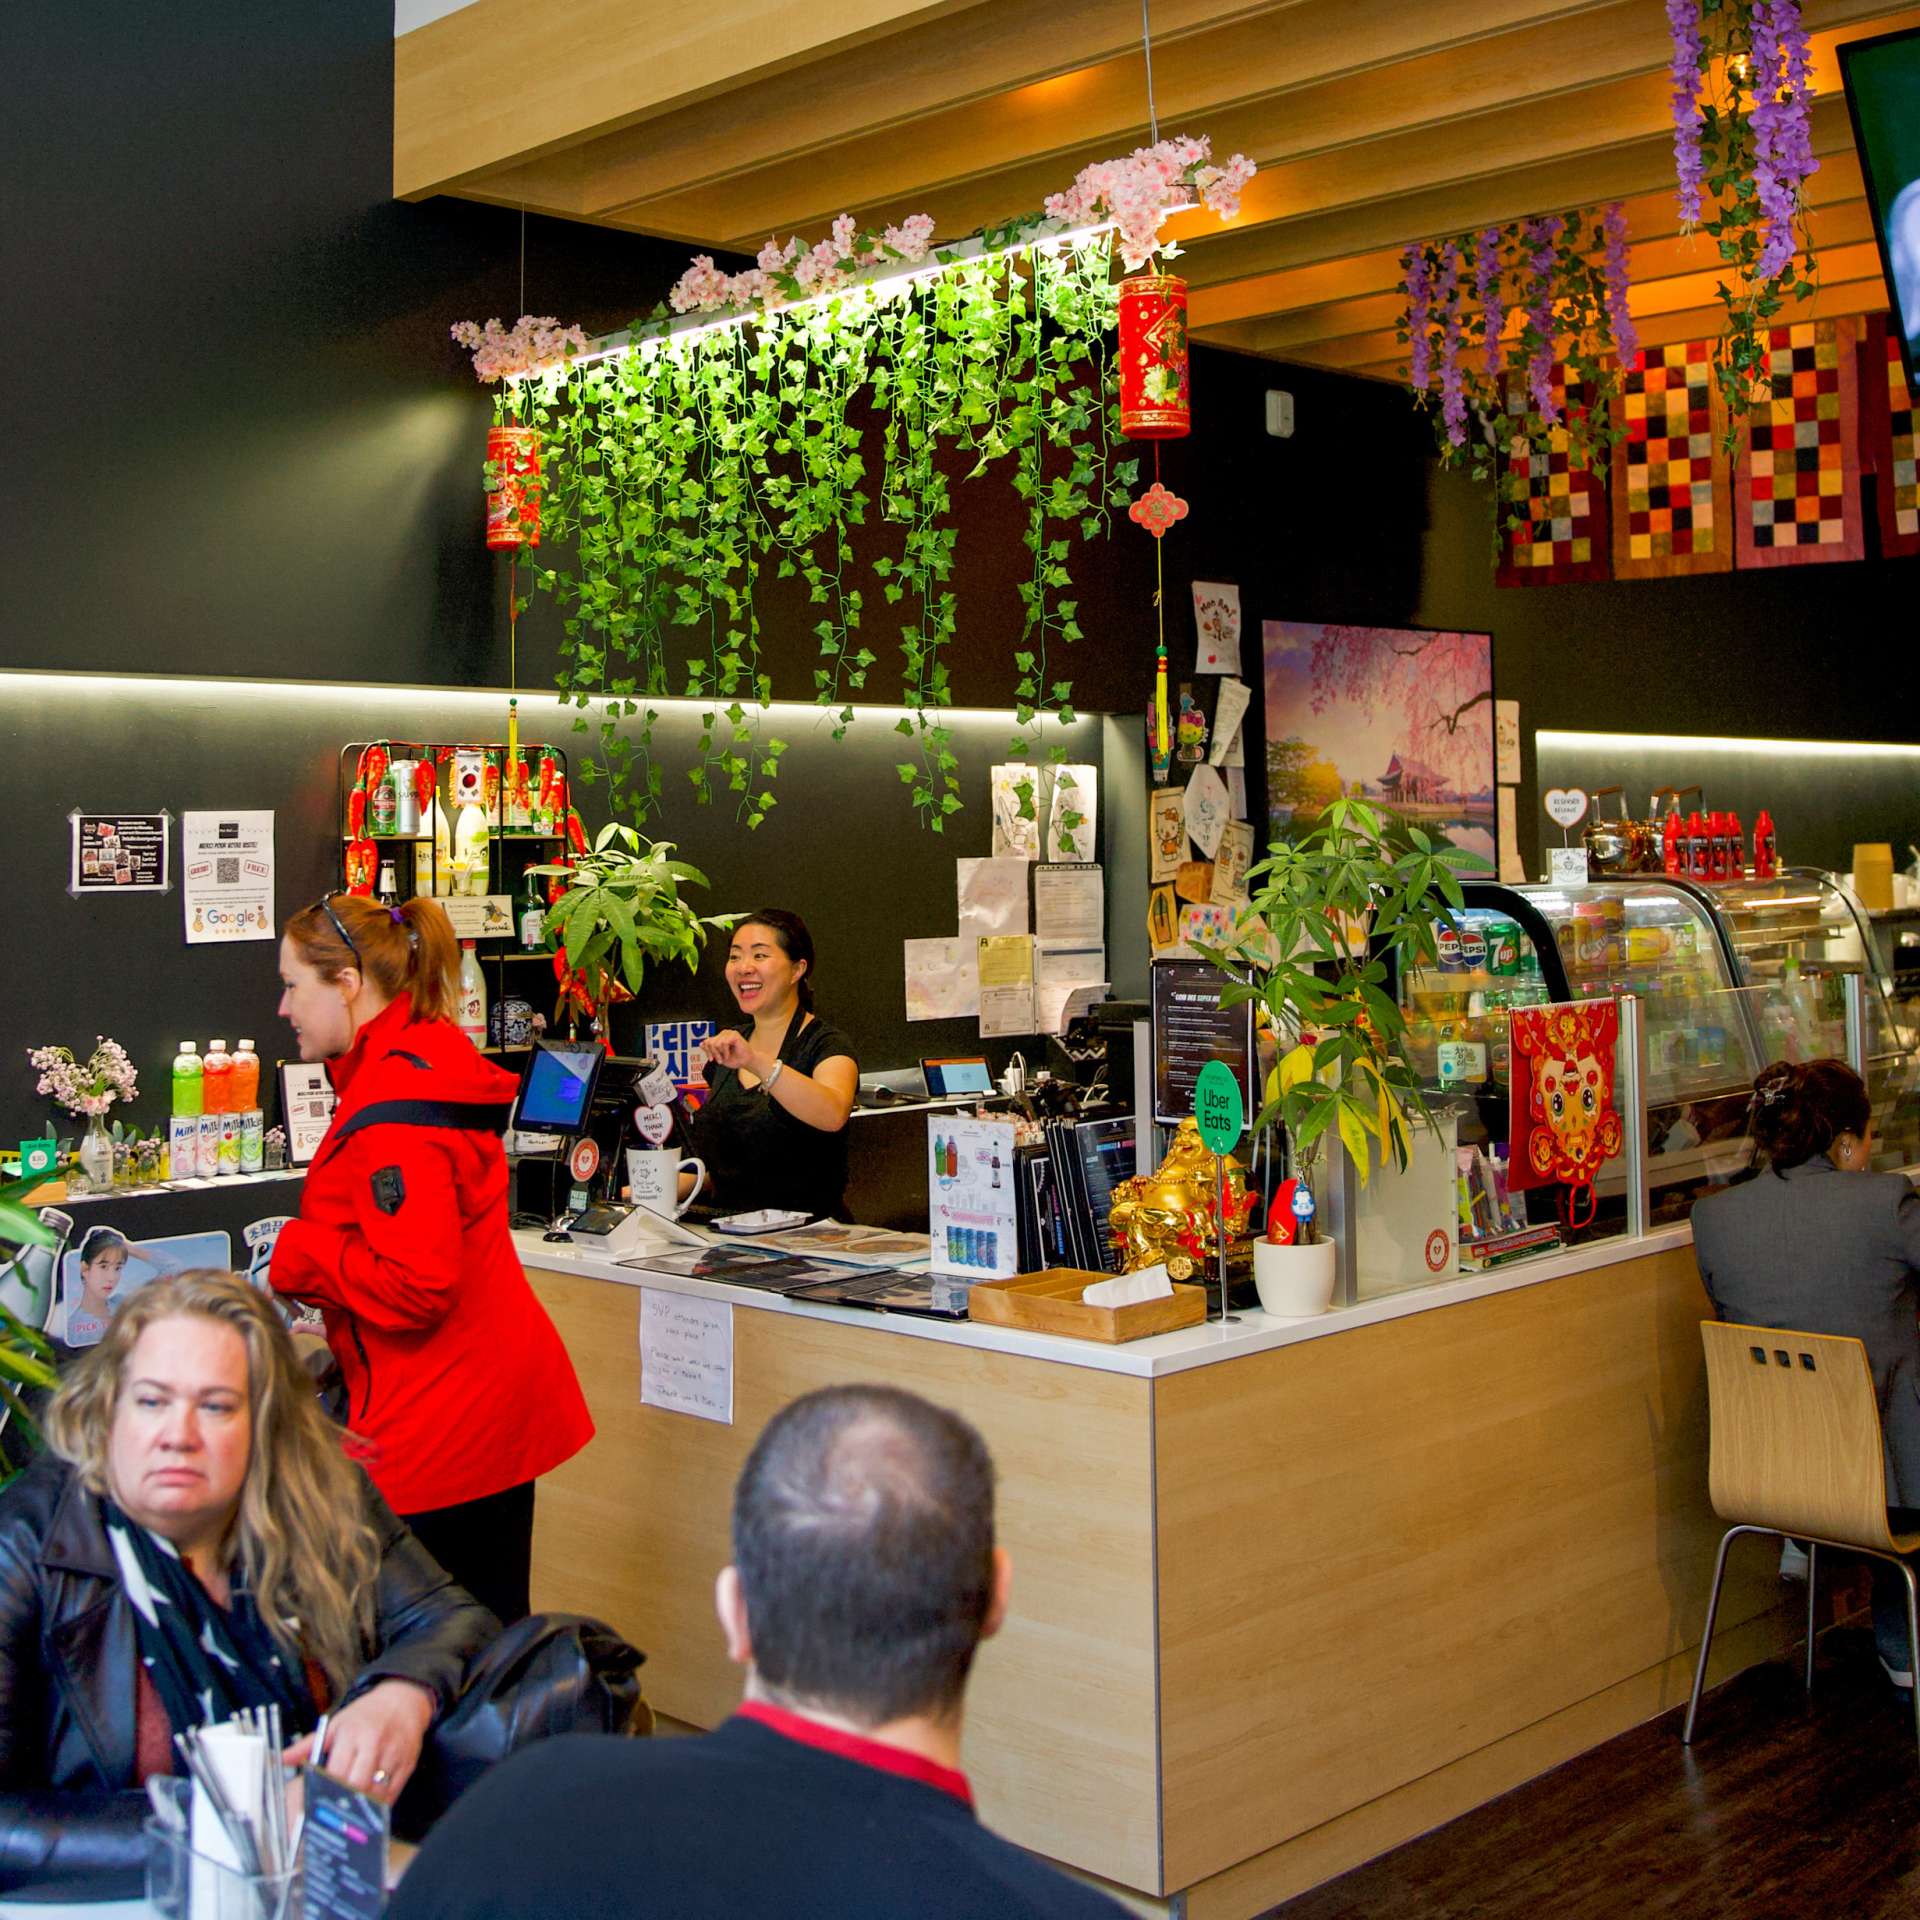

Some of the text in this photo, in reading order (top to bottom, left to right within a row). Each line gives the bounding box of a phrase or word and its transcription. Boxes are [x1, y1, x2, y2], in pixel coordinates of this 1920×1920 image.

[207, 908, 255, 927] Google
[1440, 943, 1463, 951] PEP
[1462, 945, 1486, 954] EPSI
[1489, 936, 1505, 968] 7
[1203, 1087, 1230, 1110] Uber
[1204, 1110, 1232, 1132] Eats
